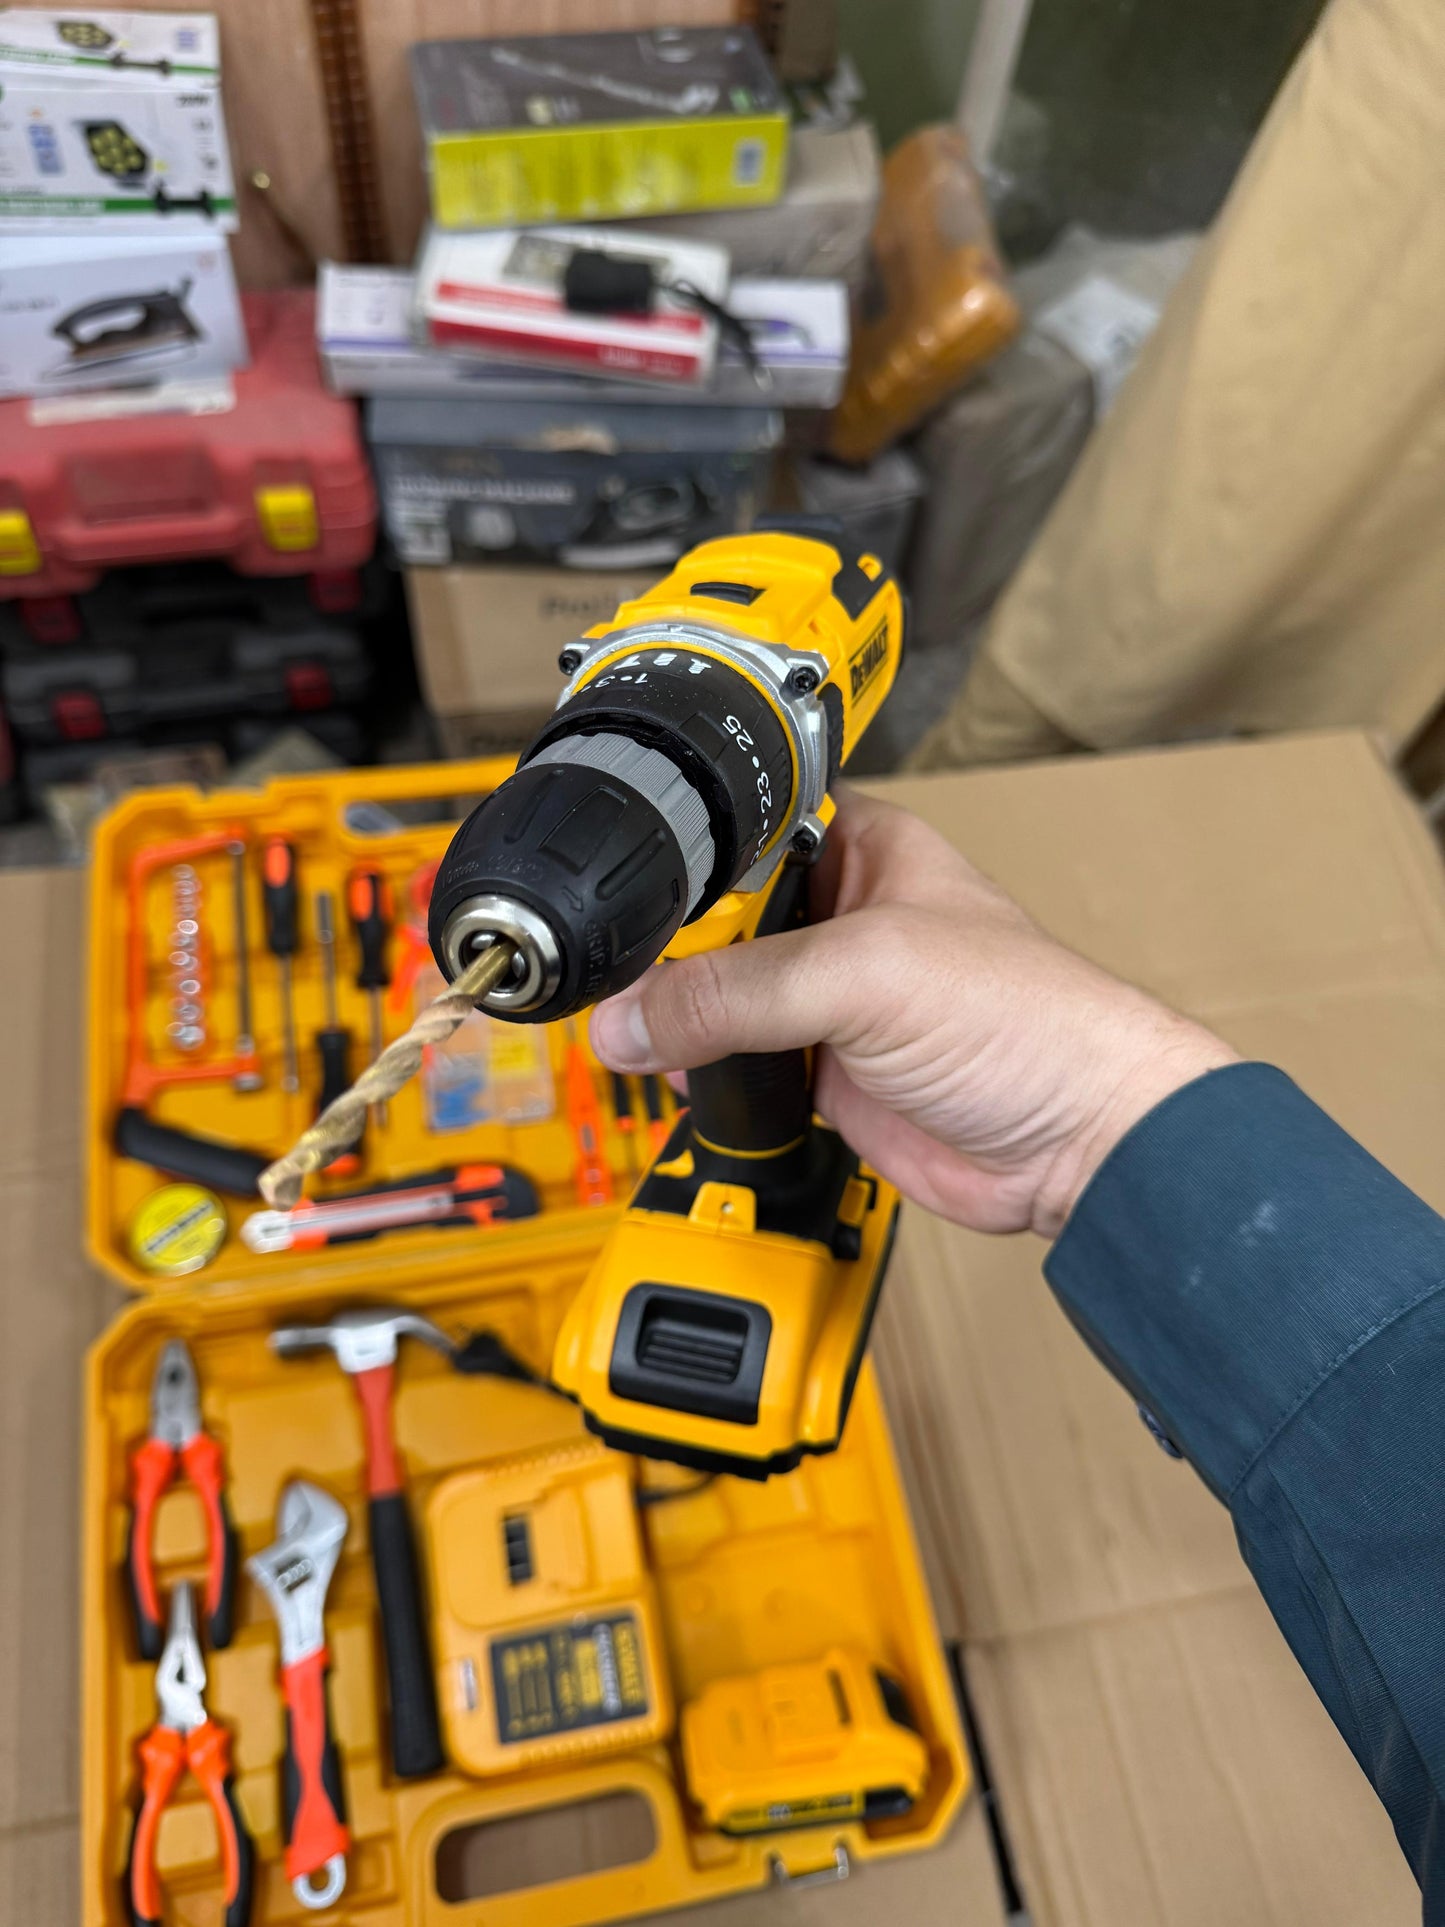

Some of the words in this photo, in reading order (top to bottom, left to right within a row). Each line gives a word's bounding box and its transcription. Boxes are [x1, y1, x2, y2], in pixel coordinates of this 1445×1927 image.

[850, 623, 888, 699] DEWALT
[722, 714, 754, 752] 25
[757, 771, 772, 814] 23
